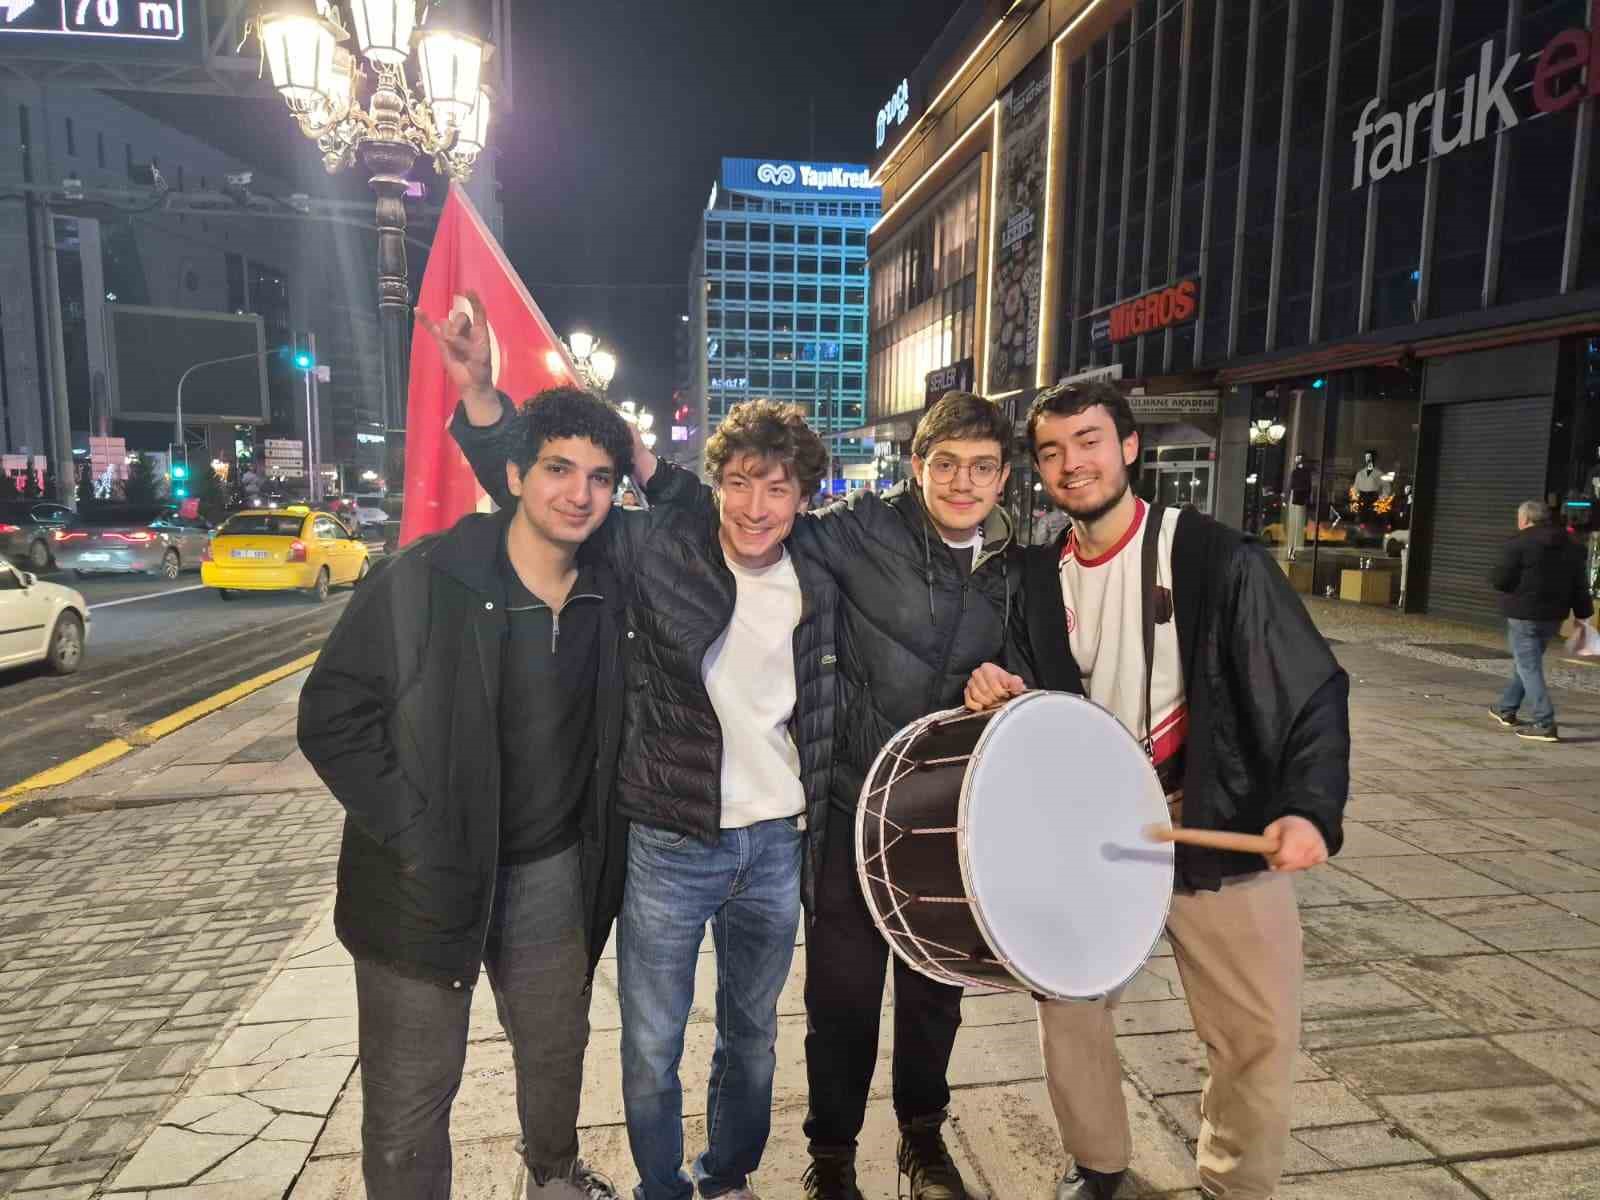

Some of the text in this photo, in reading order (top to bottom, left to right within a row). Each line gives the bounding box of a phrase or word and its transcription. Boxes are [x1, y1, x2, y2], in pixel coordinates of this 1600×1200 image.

[75, 0, 175, 30] 70 m
[1351, 0, 1600, 191] faruk e
